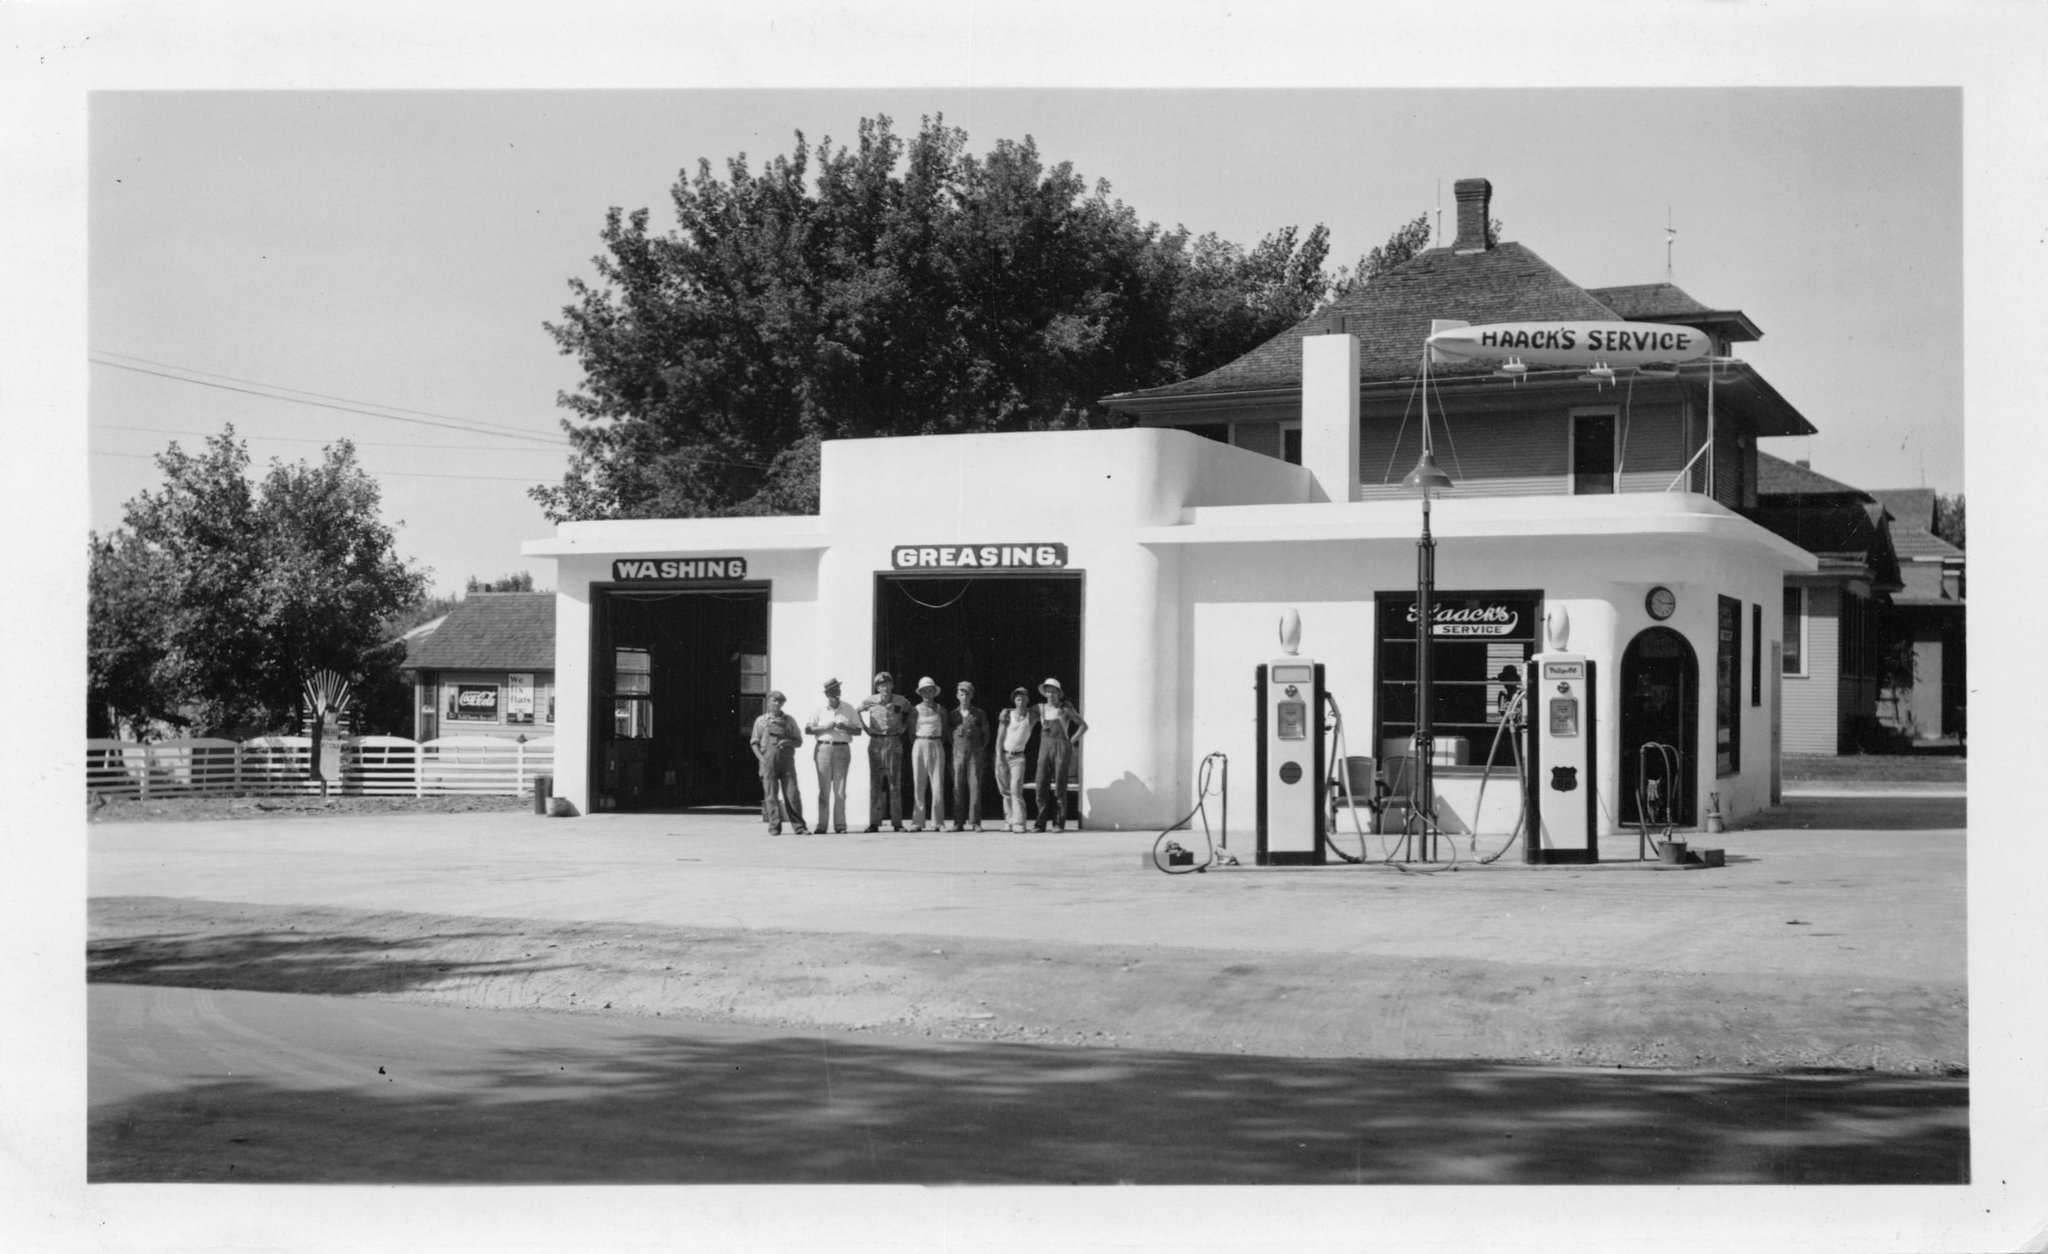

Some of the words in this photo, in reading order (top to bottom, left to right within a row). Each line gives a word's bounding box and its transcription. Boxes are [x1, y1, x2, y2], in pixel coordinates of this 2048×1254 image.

[1481, 327, 1576, 350] HAACK'S
[1588, 329, 1692, 352] SERVICE
[896, 546, 1063, 568] GREASING.
[1442, 625, 1504, 634] SERVICE
[510, 675, 524, 684] We
[510, 685, 524, 693] fix
[460, 691, 496, 706] Coca-Cola
[510, 695, 531, 704] flats
